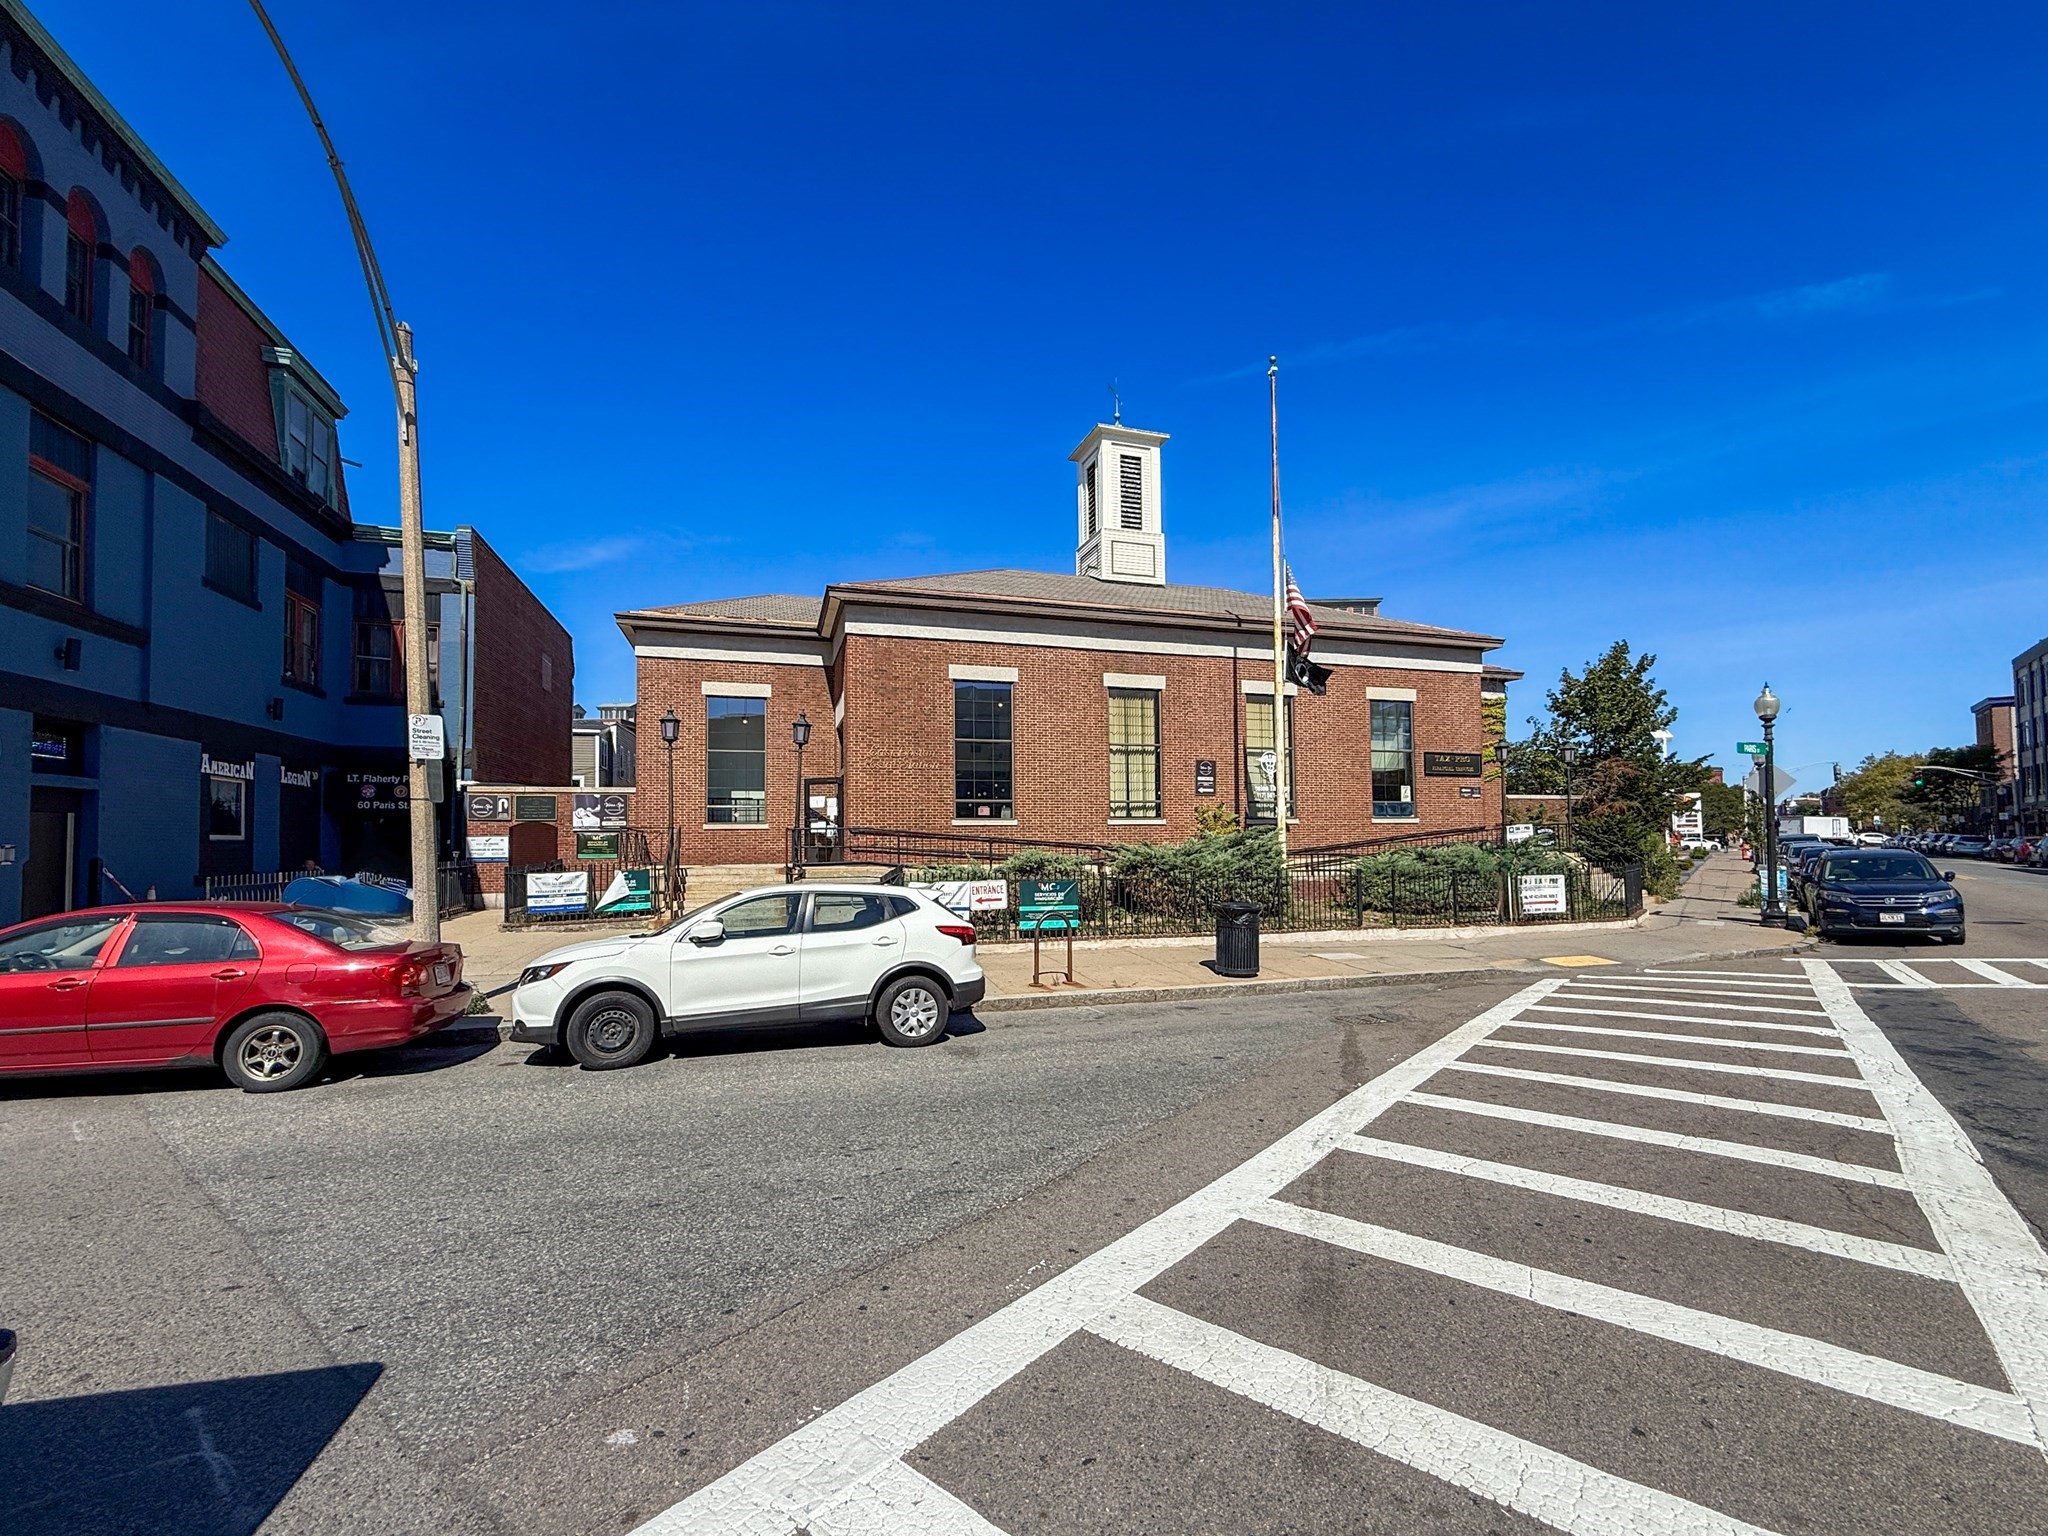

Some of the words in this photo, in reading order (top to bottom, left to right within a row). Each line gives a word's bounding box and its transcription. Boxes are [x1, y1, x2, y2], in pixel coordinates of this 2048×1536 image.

[1743, 744, 1757, 753] PARIS
[1454, 755, 1471, 763] PRO
[201, 753, 255, 780] AMERICAN
[280, 766, 311, 787] LEGION
[347, 774, 360, 783] LT.
[363, 774, 400, 785] Flaherty
[357, 801, 371, 809] 60
[373, 801, 396, 809] Paris
[398, 801, 410, 809] St.
[971, 884, 1004, 896] ENTRANCE
[1040, 882, 1056, 891] MC
